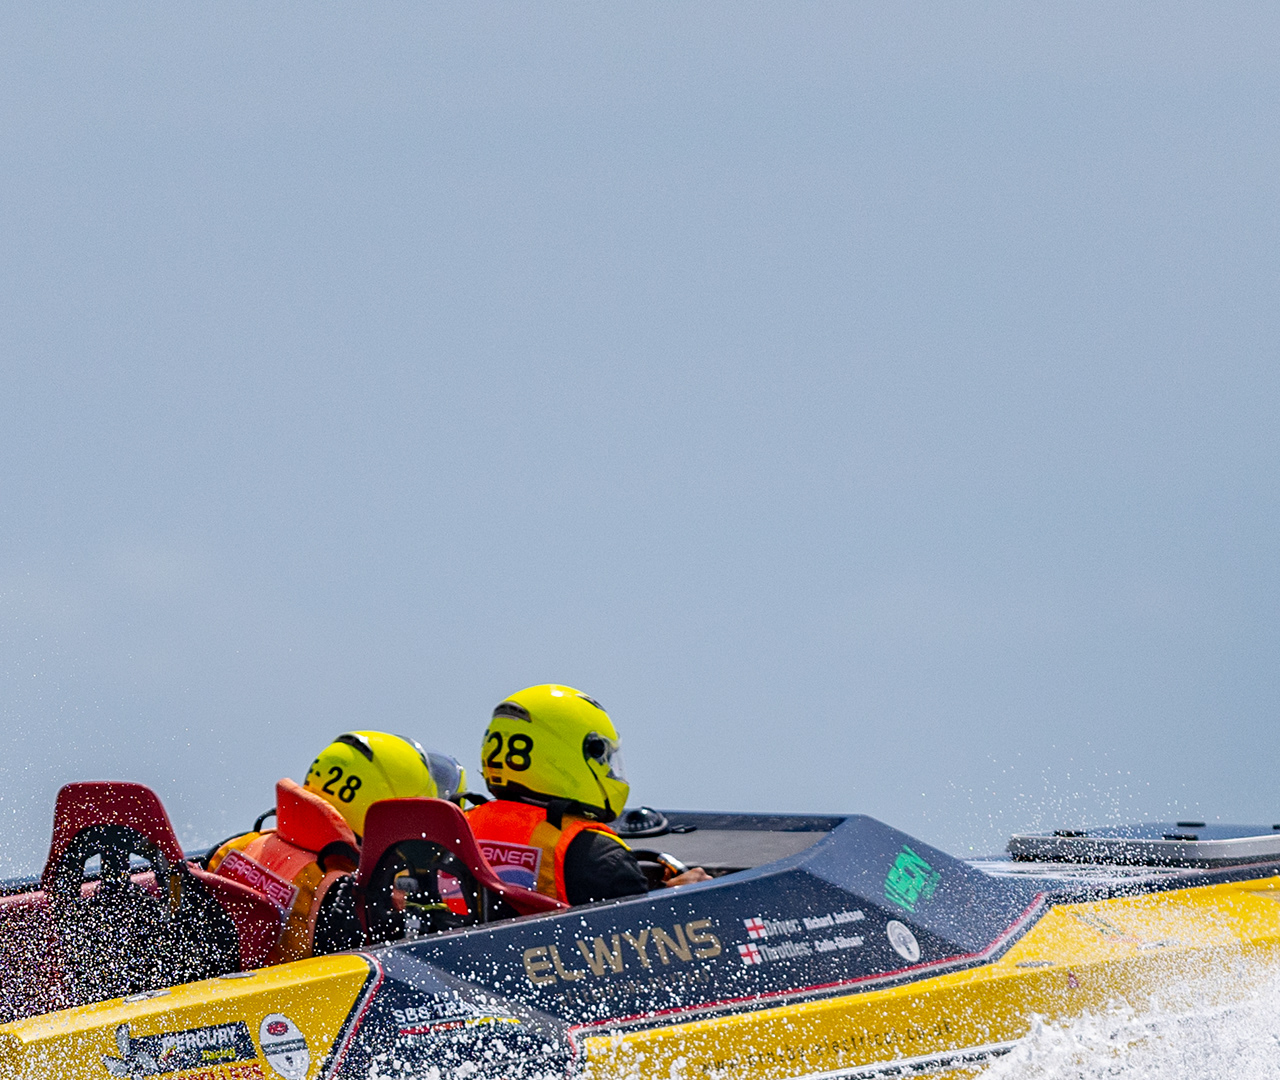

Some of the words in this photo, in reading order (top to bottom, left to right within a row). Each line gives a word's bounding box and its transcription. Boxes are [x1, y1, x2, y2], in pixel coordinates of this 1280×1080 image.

[483, 730, 534, 771] 28
[481, 847, 536, 866] BNER
[523, 919, 721, 985] ELWYNS
[394, 1006, 430, 1022] SBS
[161, 1025, 236, 1053] MERCURY
[202, 1047, 235, 1060] Racing
